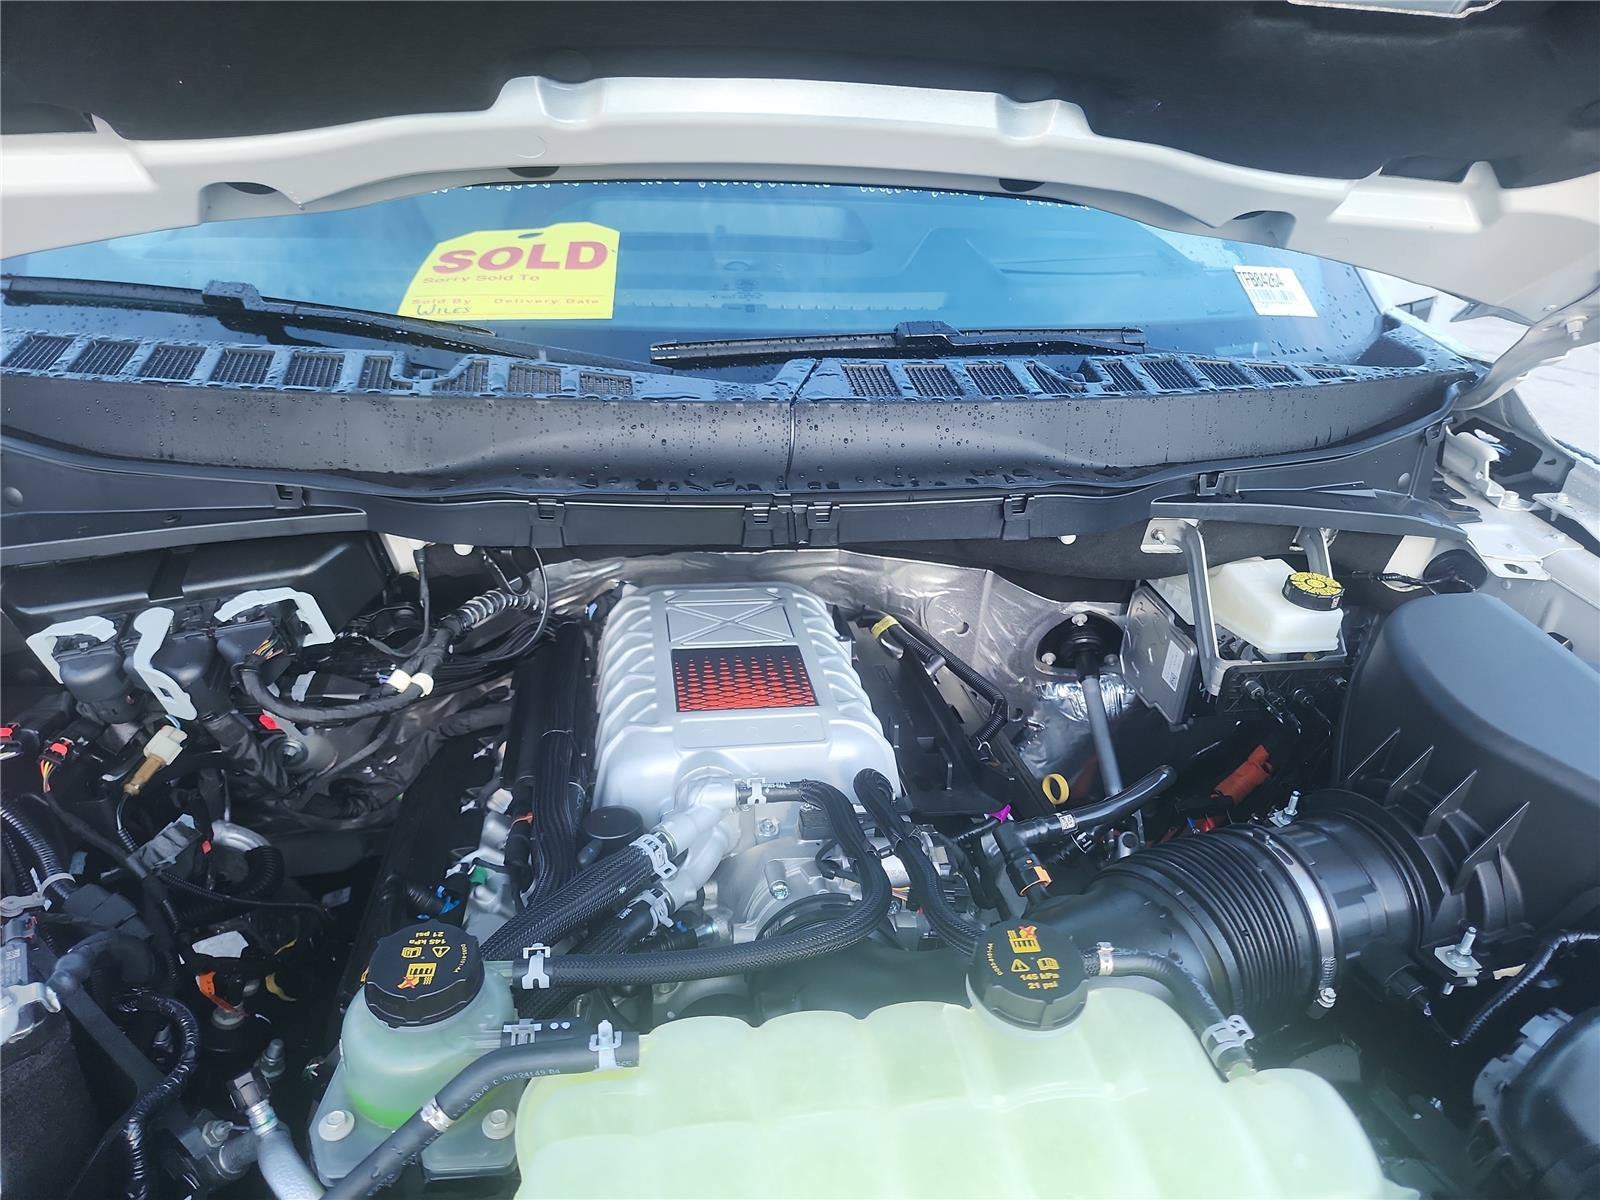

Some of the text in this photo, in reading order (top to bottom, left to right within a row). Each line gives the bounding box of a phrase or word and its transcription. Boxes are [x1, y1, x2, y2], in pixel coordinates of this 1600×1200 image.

[432, 241, 608, 274] SOLD
[423, 274, 540, 284] Sorry Sold To
[452, 297, 471, 305] By
[493, 297, 600, 305] Delivery Date
[415, 930, 431, 938] psi
[1020, 973, 1040, 981] 145
[1027, 982, 1041, 990] 21
